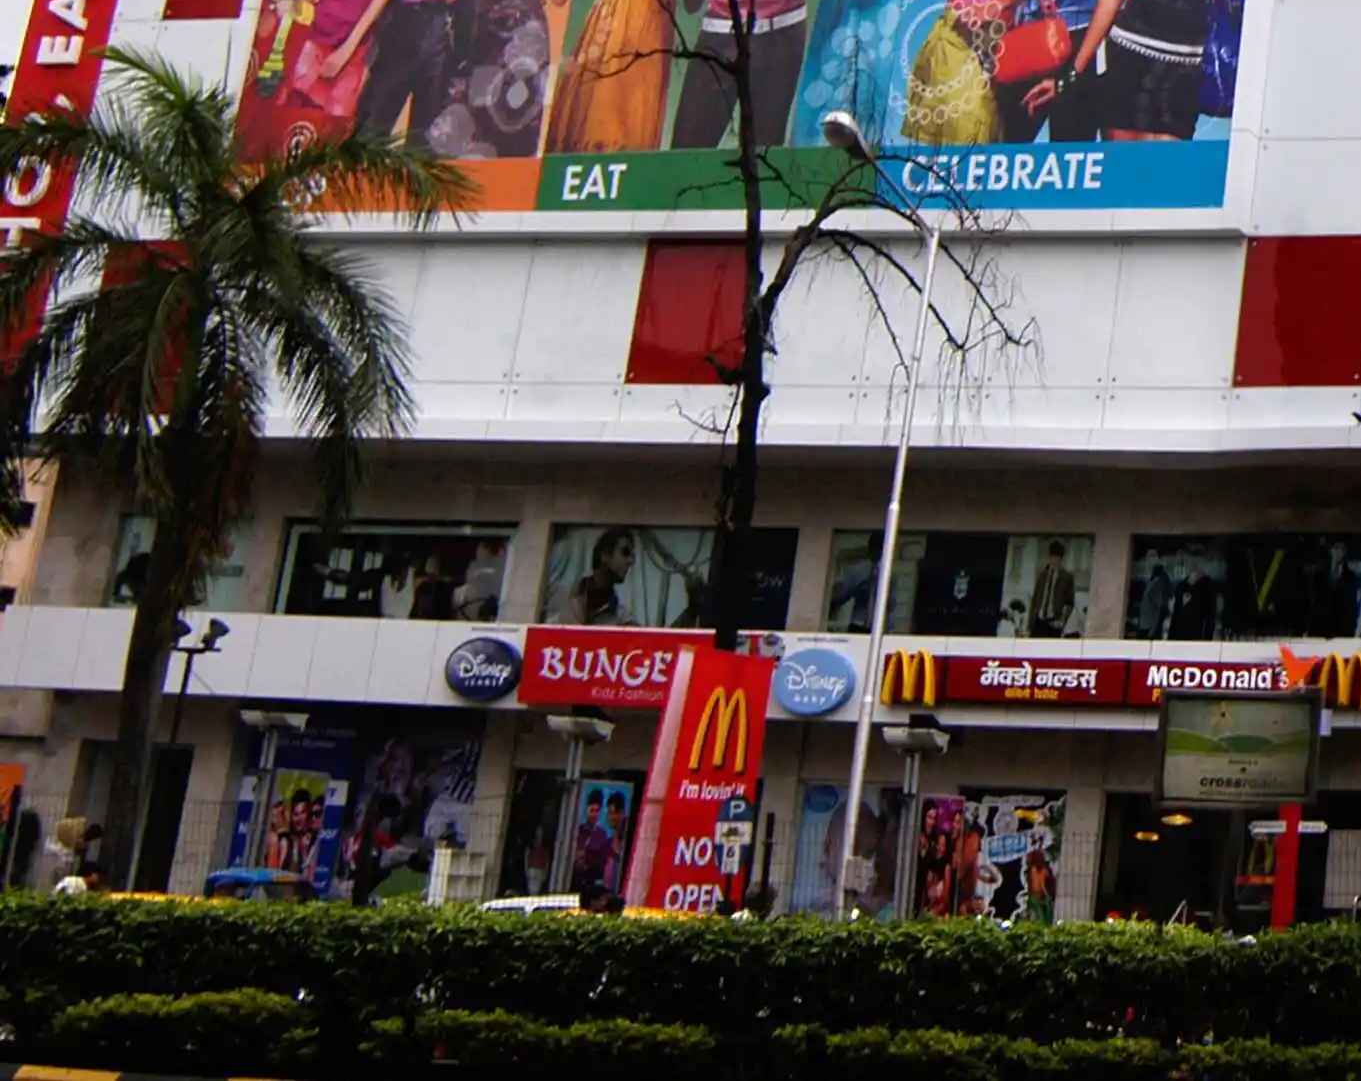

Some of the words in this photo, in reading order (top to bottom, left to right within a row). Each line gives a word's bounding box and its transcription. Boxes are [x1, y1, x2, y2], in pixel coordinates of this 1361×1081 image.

[561, 163, 628, 201] EAT
[903, 152, 1105, 192] CELEBRATE
[459, 651, 512, 684] Disney
[782, 661, 848, 700] Disney
[618, 687, 665, 702] Fashion
[679, 779, 700, 800] I'm
[701, 780, 736, 801] lovin'
[728, 799, 747, 819] P
[673, 835, 714, 867] NO
